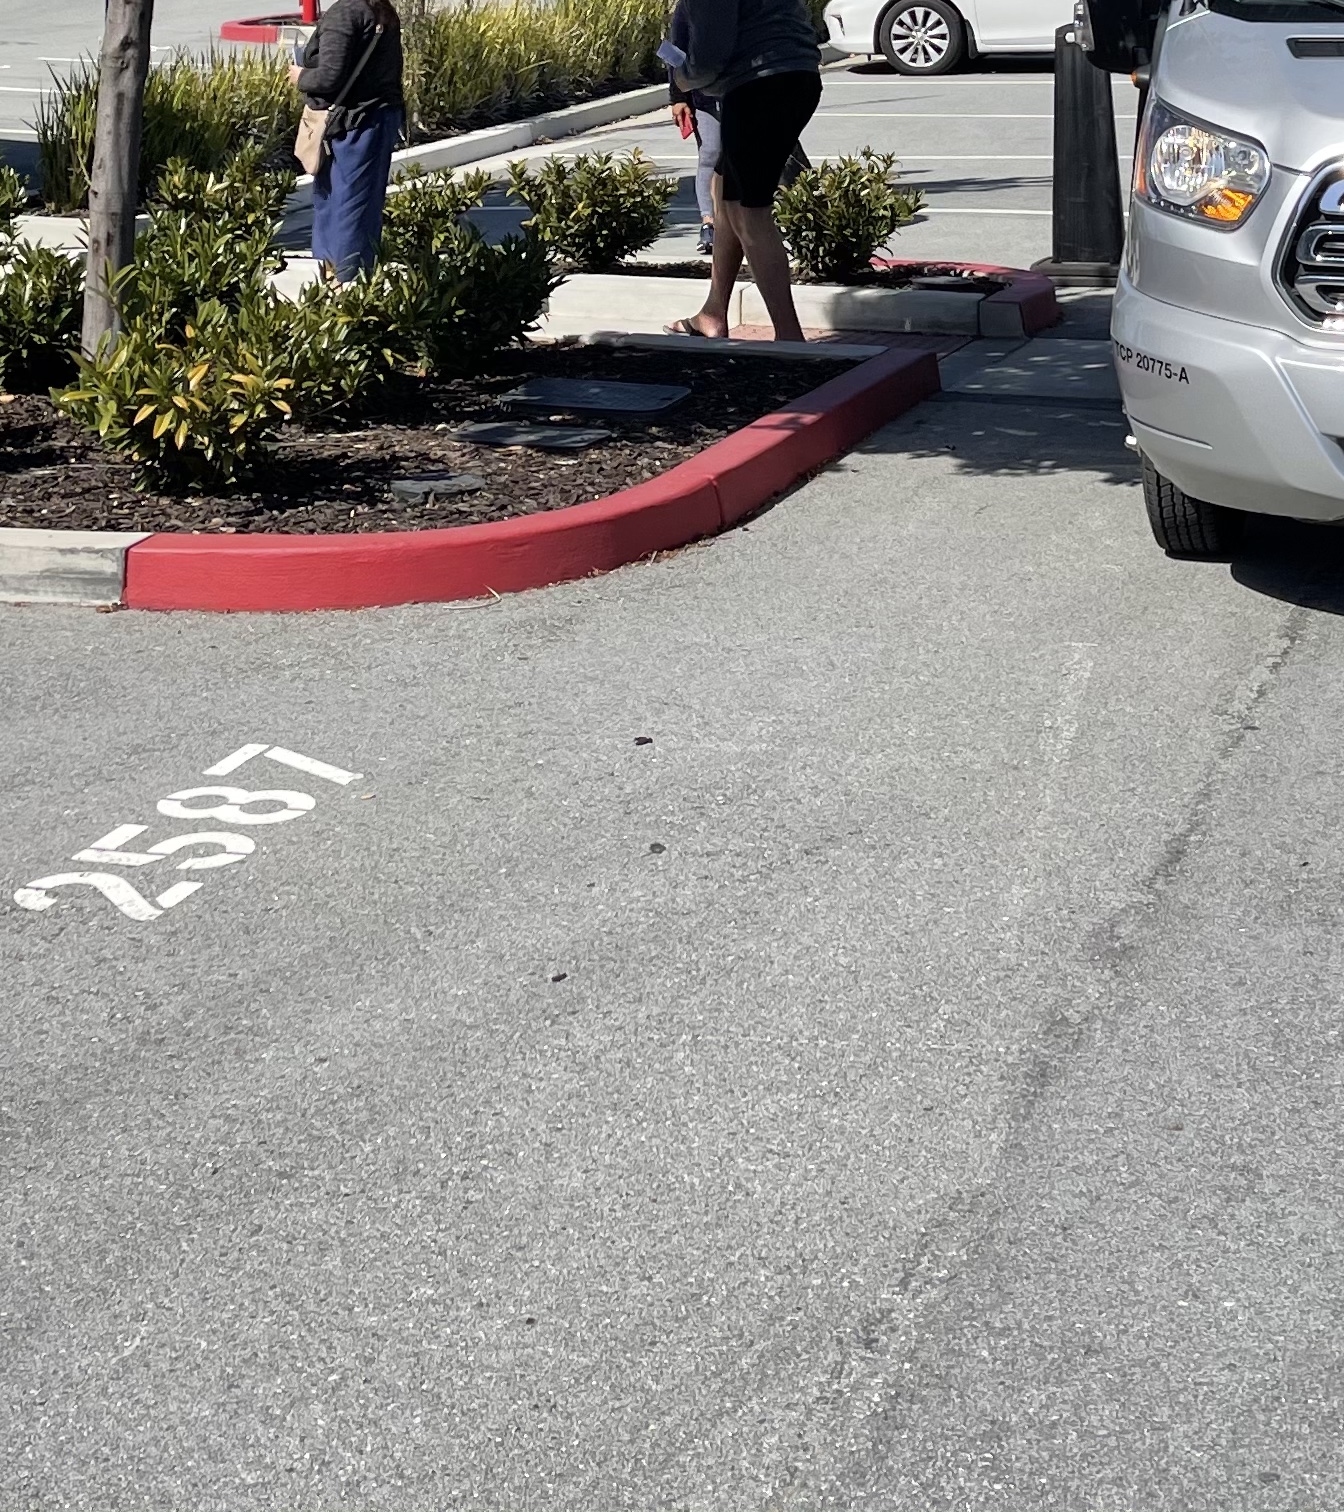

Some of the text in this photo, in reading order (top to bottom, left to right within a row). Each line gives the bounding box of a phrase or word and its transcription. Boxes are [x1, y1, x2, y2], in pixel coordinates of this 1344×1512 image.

[1115, 340, 1190, 385] TCP 20775-A
[13, 743, 364, 921] 2587
